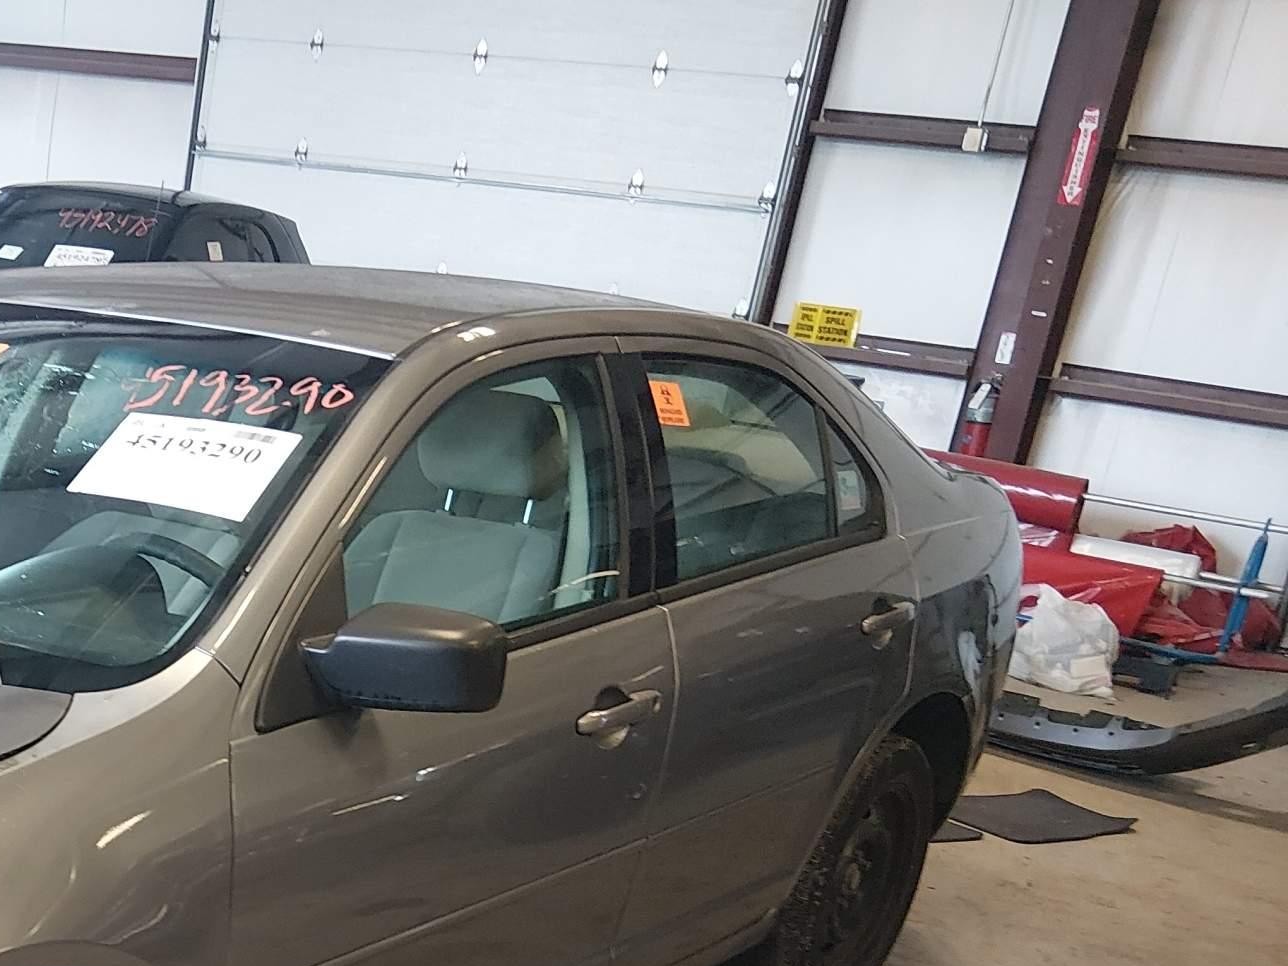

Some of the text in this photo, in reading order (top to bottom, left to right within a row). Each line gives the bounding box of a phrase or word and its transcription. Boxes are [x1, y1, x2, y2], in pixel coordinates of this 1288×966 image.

[825, 316, 846, 326] SPILL
[817, 325, 848, 336] STATION
[126, 433, 262, 464] 45193290
